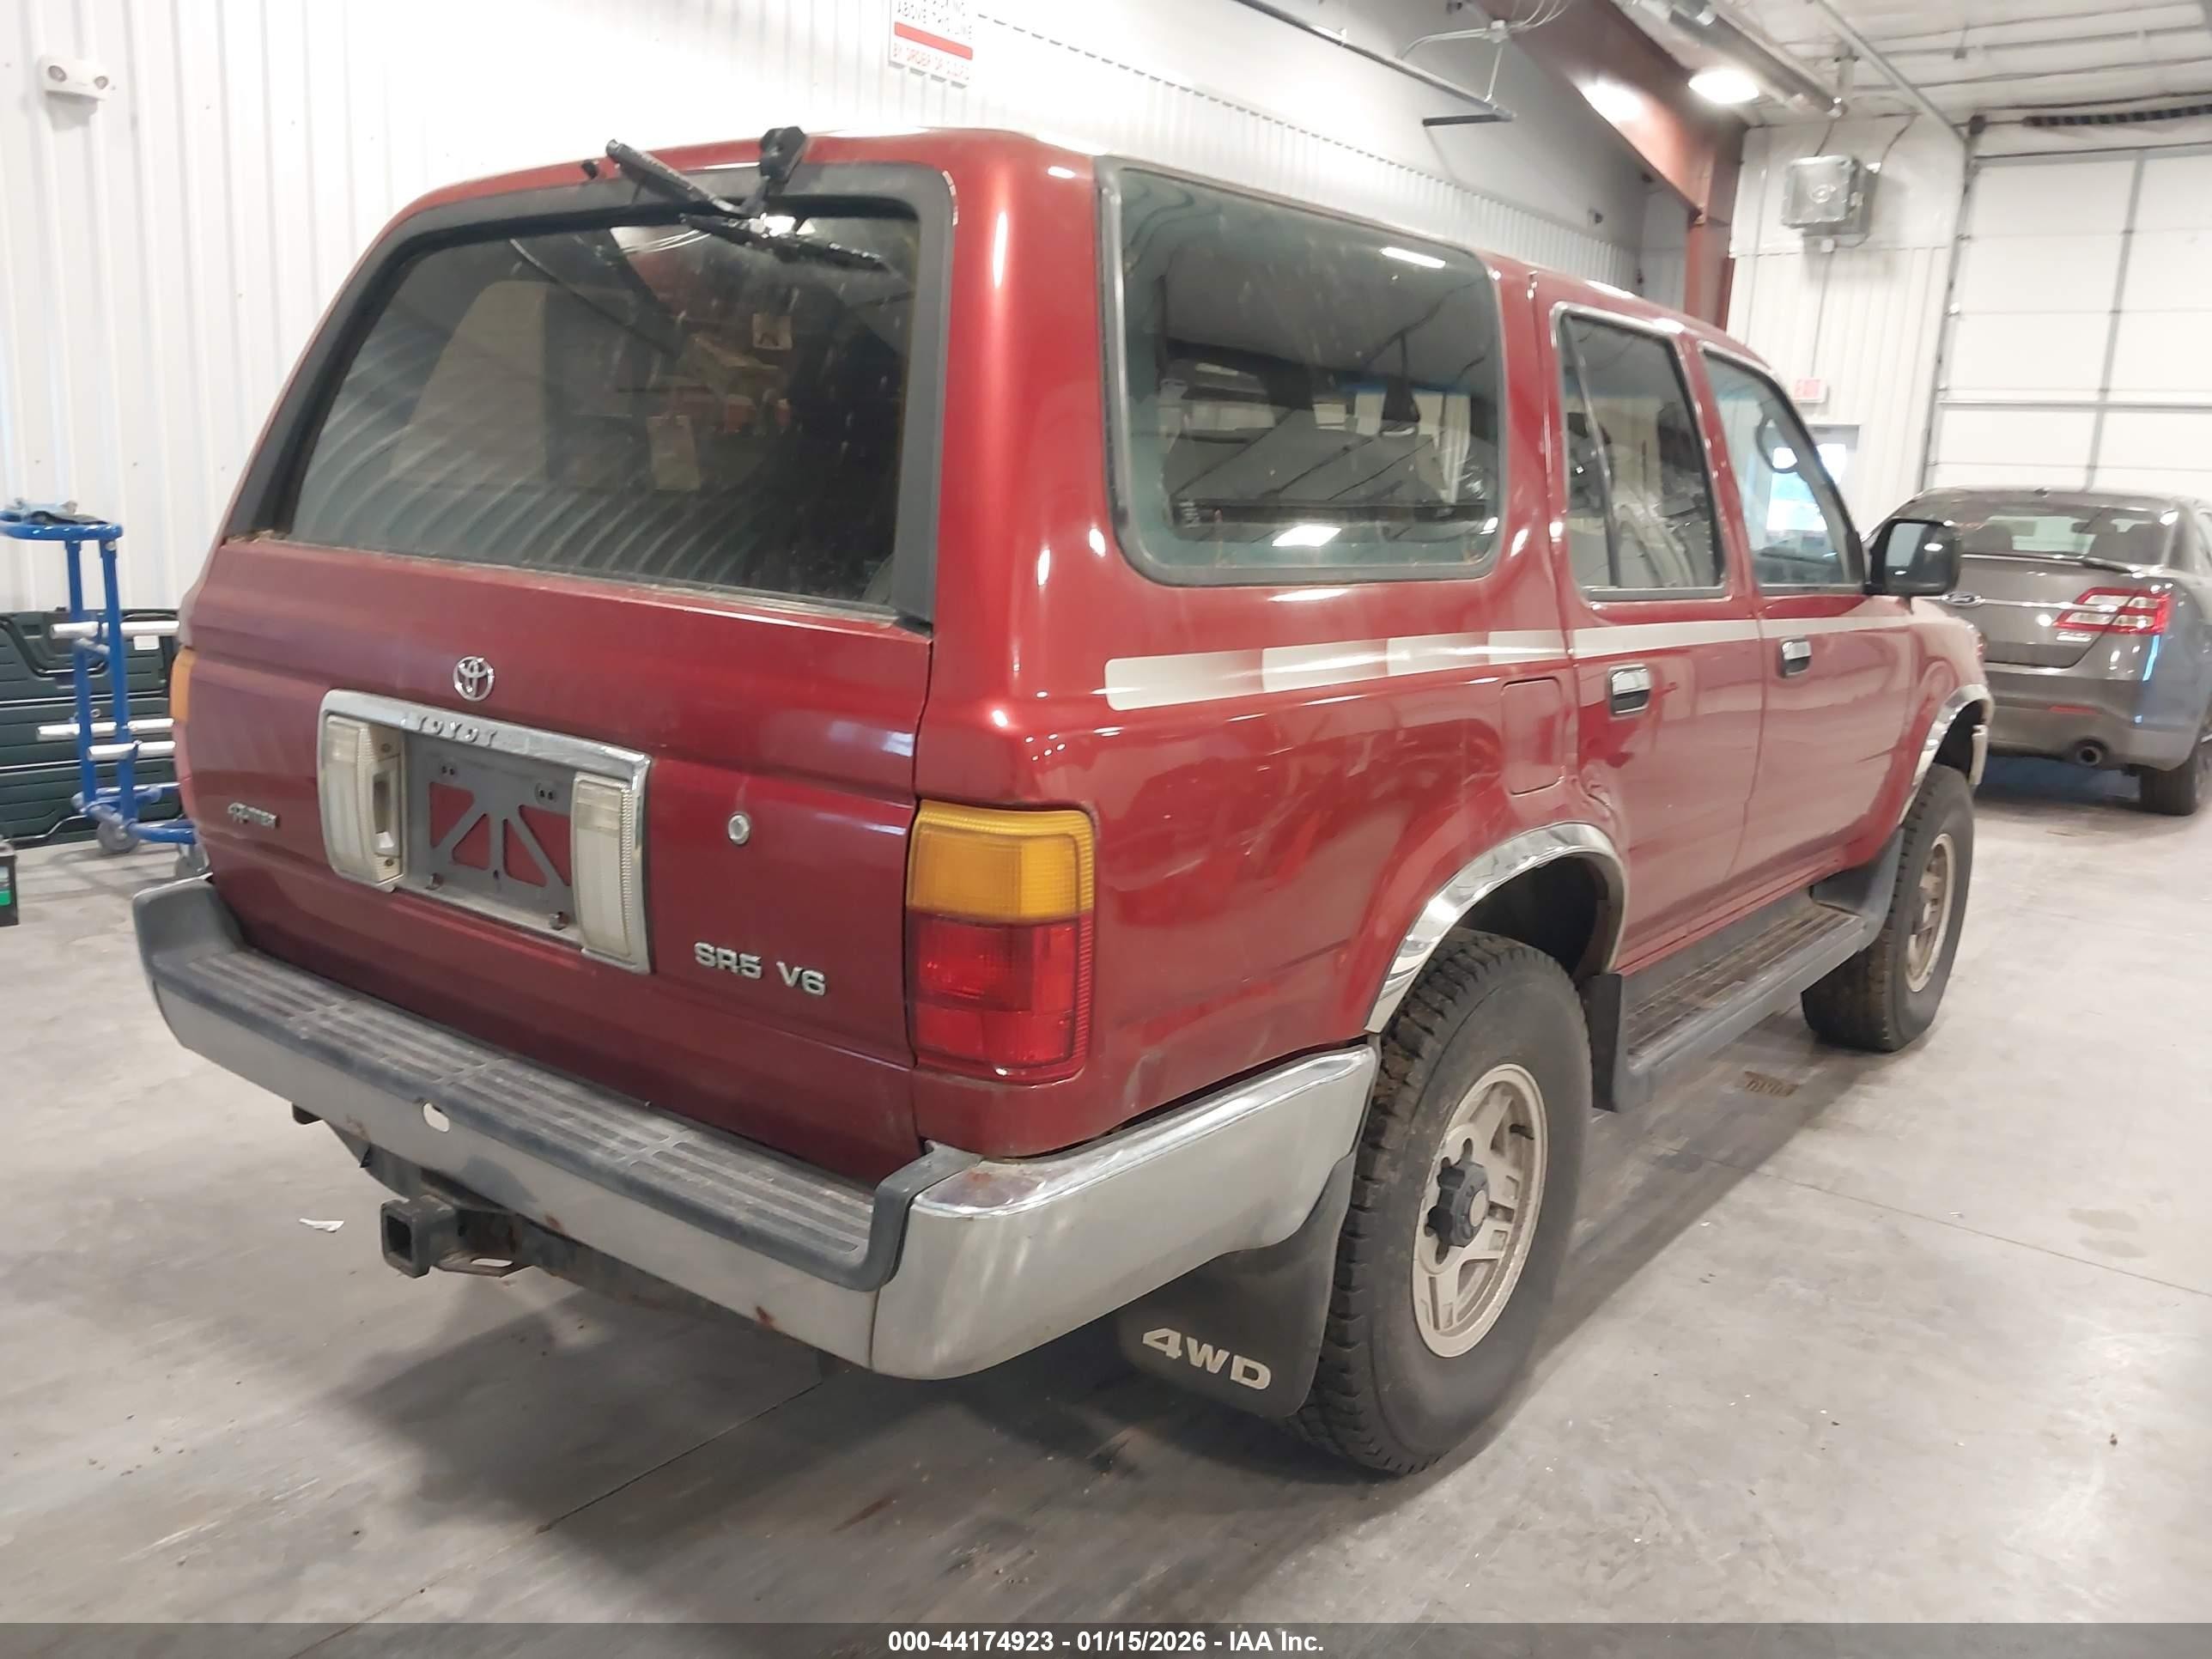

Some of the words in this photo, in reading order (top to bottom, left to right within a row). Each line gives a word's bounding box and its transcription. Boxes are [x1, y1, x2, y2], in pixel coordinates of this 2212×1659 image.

[415, 714, 517, 750] TOYOT
[694, 941, 763, 980] SR5
[775, 960, 826, 997] V6
[1142, 1328, 1272, 1390] 4WD
